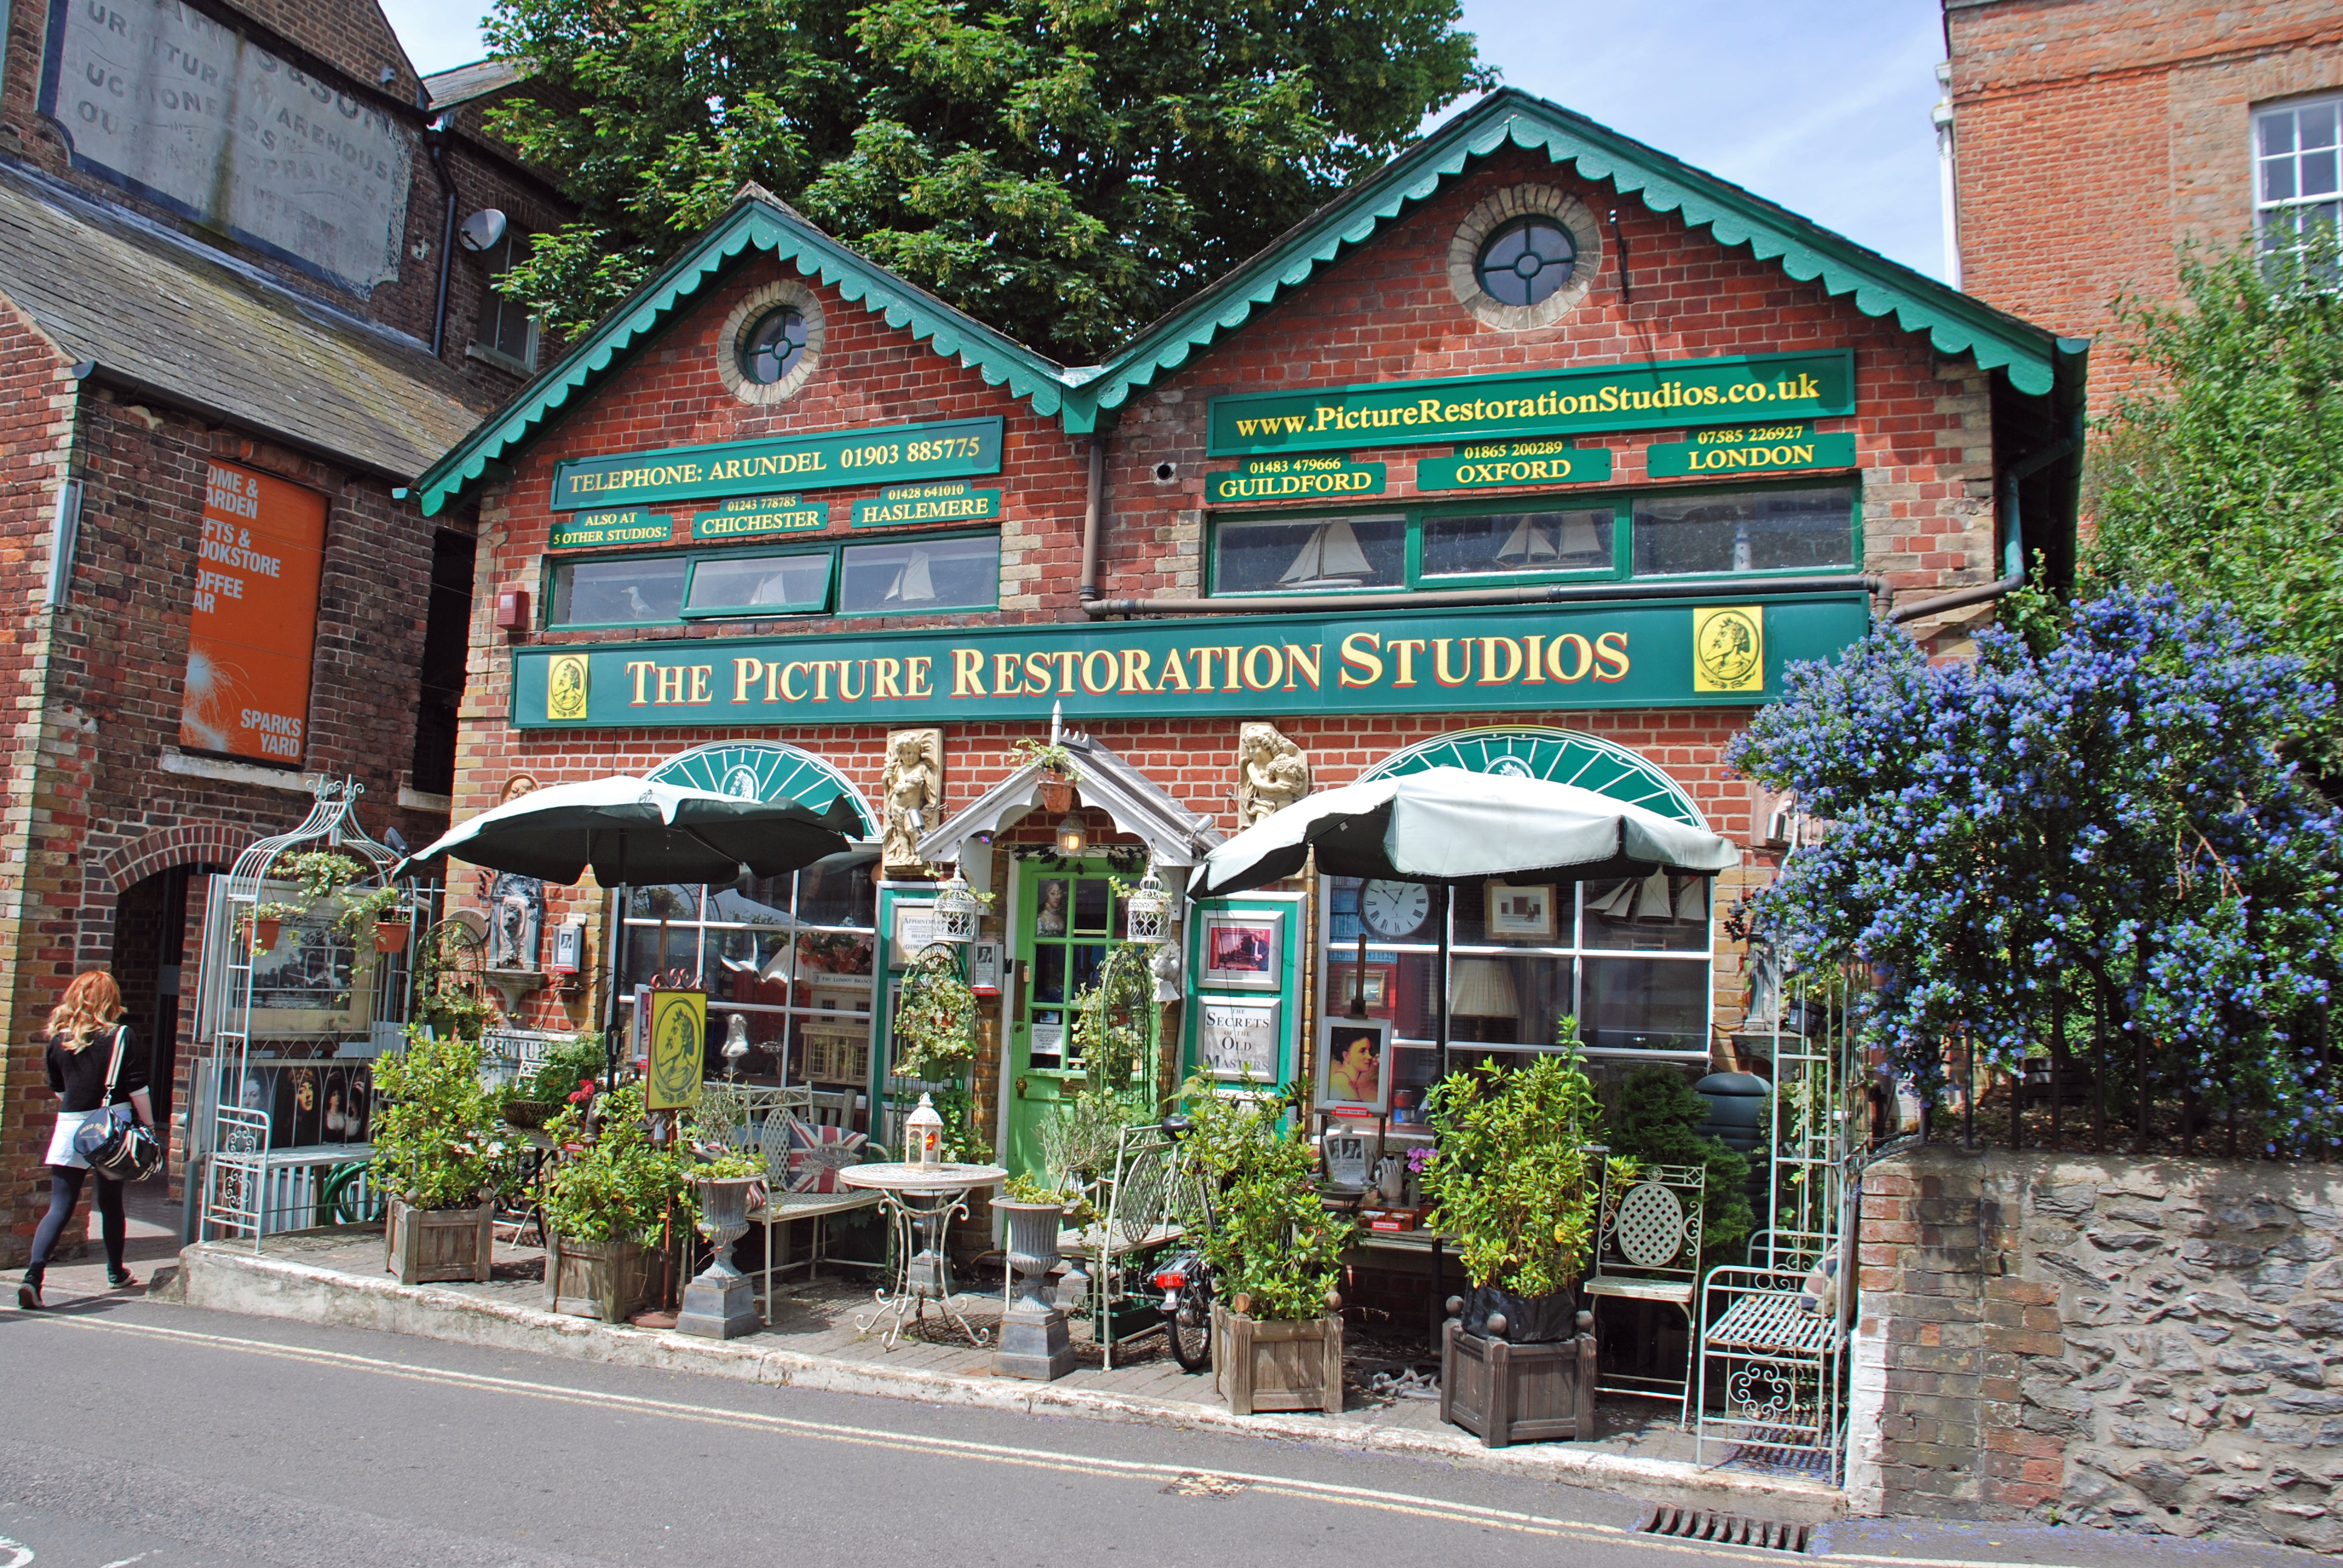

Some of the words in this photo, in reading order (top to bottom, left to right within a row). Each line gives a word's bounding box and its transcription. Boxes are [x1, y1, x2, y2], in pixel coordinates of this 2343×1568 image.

[1236, 373, 1820, 437] www.PictureRestorationStudios.co.uk
[1698, 430, 1743, 445] 07585
[1749, 425, 1803, 441] 226927
[1464, 445, 1507, 459] 01865
[1512, 441, 1563, 456] 200289
[1688, 444, 1815, 470] LONDON
[569, 464, 702, 493] TELEPHONE:
[709, 451, 827, 480] ARUNDEL
[840, 444, 899, 468] 01903
[906, 436, 980, 462] 885775
[1250, 460, 1289, 474] 01483
[1293, 457, 1342, 471] 479666
[1455, 459, 1572, 483] OXFORD
[207, 465, 243, 494] OME
[246, 478, 259, 499] &
[888, 488, 920, 501] 01428
[923, 484, 964, 498] 641010
[1219, 471, 1372, 498] GUILDFORD
[206, 486, 258, 520] ARDEN
[727, 499, 757, 512] 01243
[761, 496, 796, 509] 778785
[862, 498, 989, 523] HASLEMERE
[585, 513, 617, 526] ALSO
[619, 512, 637, 524] AT
[701, 511, 820, 535] CHICHESTER
[238, 528, 251, 549] &
[553, 534, 560, 544] 5
[562, 530, 603, 544] OTHER
[606, 526, 667, 541] STUDIOS:
[198, 538, 281, 578] OOKSTORE
[195, 569, 244, 599] OFFEE
[192, 590, 215, 614] AR
[624, 661, 713, 707] THE
[729, 656, 933, 705] PICTURE
[948, 644, 1323, 699] RESTORATION
[1338, 632, 1630, 689] STUDIOS
[241, 708, 302, 737] SPARKS
[260, 732, 300, 757] YARD
[1206, 1011, 1270, 1028] SECRETS
[1222, 1036, 1252, 1051] OLD
[1205, 1054, 1269, 1071] MASTRS
